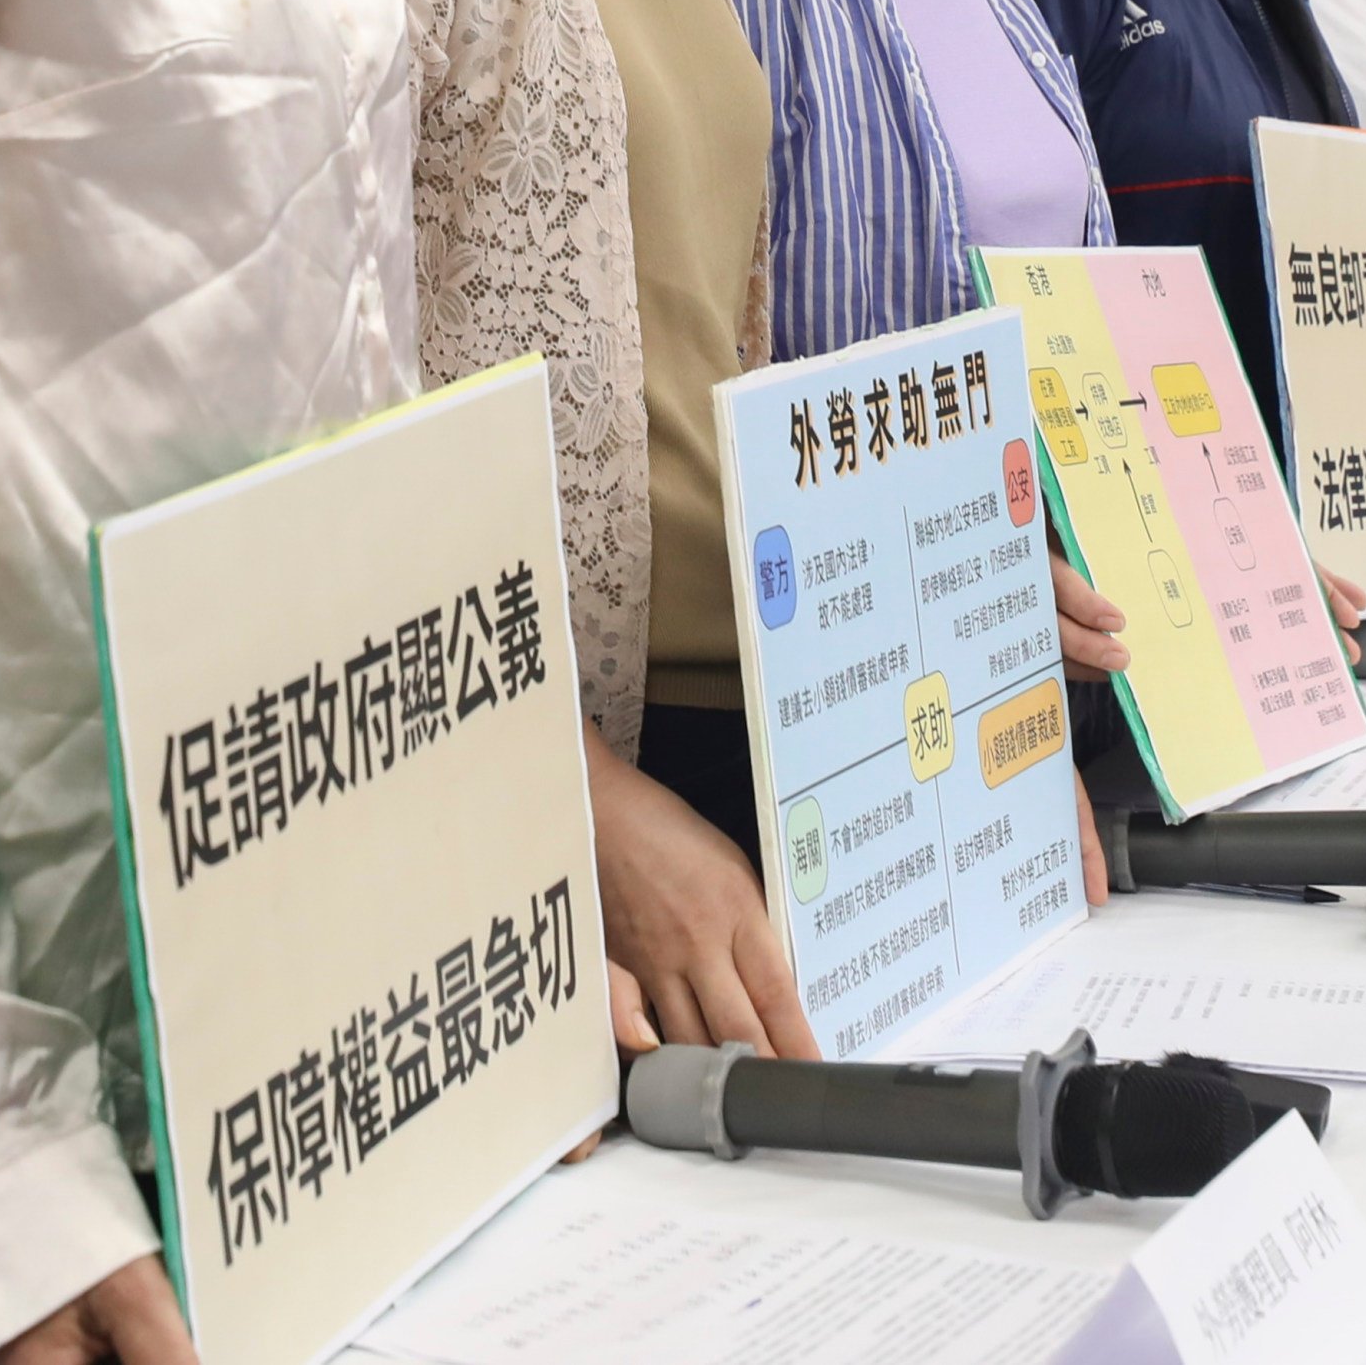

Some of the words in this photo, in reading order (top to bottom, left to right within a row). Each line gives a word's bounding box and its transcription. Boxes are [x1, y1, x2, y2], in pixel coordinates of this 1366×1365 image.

[1120, 19, 1166, 52] idas
[1024, 263, 1054, 296] 香港
[1141, 267, 1167, 298] 內地
[1046, 334, 1076, 356] 合法匯款
[789, 350, 993, 491] 外勞求助無門
[1060, 439, 1079, 459] 工友
[1006, 468, 1031, 505] 公安
[914, 491, 1000, 548] 聯絡內地公安有困難
[758, 555, 790, 601] 警方
[801, 538, 878, 591] 涉及國內法律，
[817, 582, 875, 632] 故不能處理
[953, 582, 1039, 643] 叫自行追討香港找換店
[777, 643, 910, 730] 建議去小額錢債審裁處申索
[158, 559, 547, 890] 促請政府顯公義
[910, 696, 949, 761] 求助
[980, 703, 1062, 777] 小額錢債審裁處
[791, 828, 822, 878] 海關
[829, 789, 915, 860] 不會協助追討賠償
[953, 813, 1014, 875] 追討時間漫長
[813, 843, 937, 941] 未倒閉前只能提供調解服務
[806, 899, 951, 1014] 倒閉或改名後不能協助追討賠償
[206, 875, 578, 1267] 保障權益最急切
[1194, 1241, 1297, 1355] 外勞護理員
[1289, 1197, 1342, 1275] 阿林
